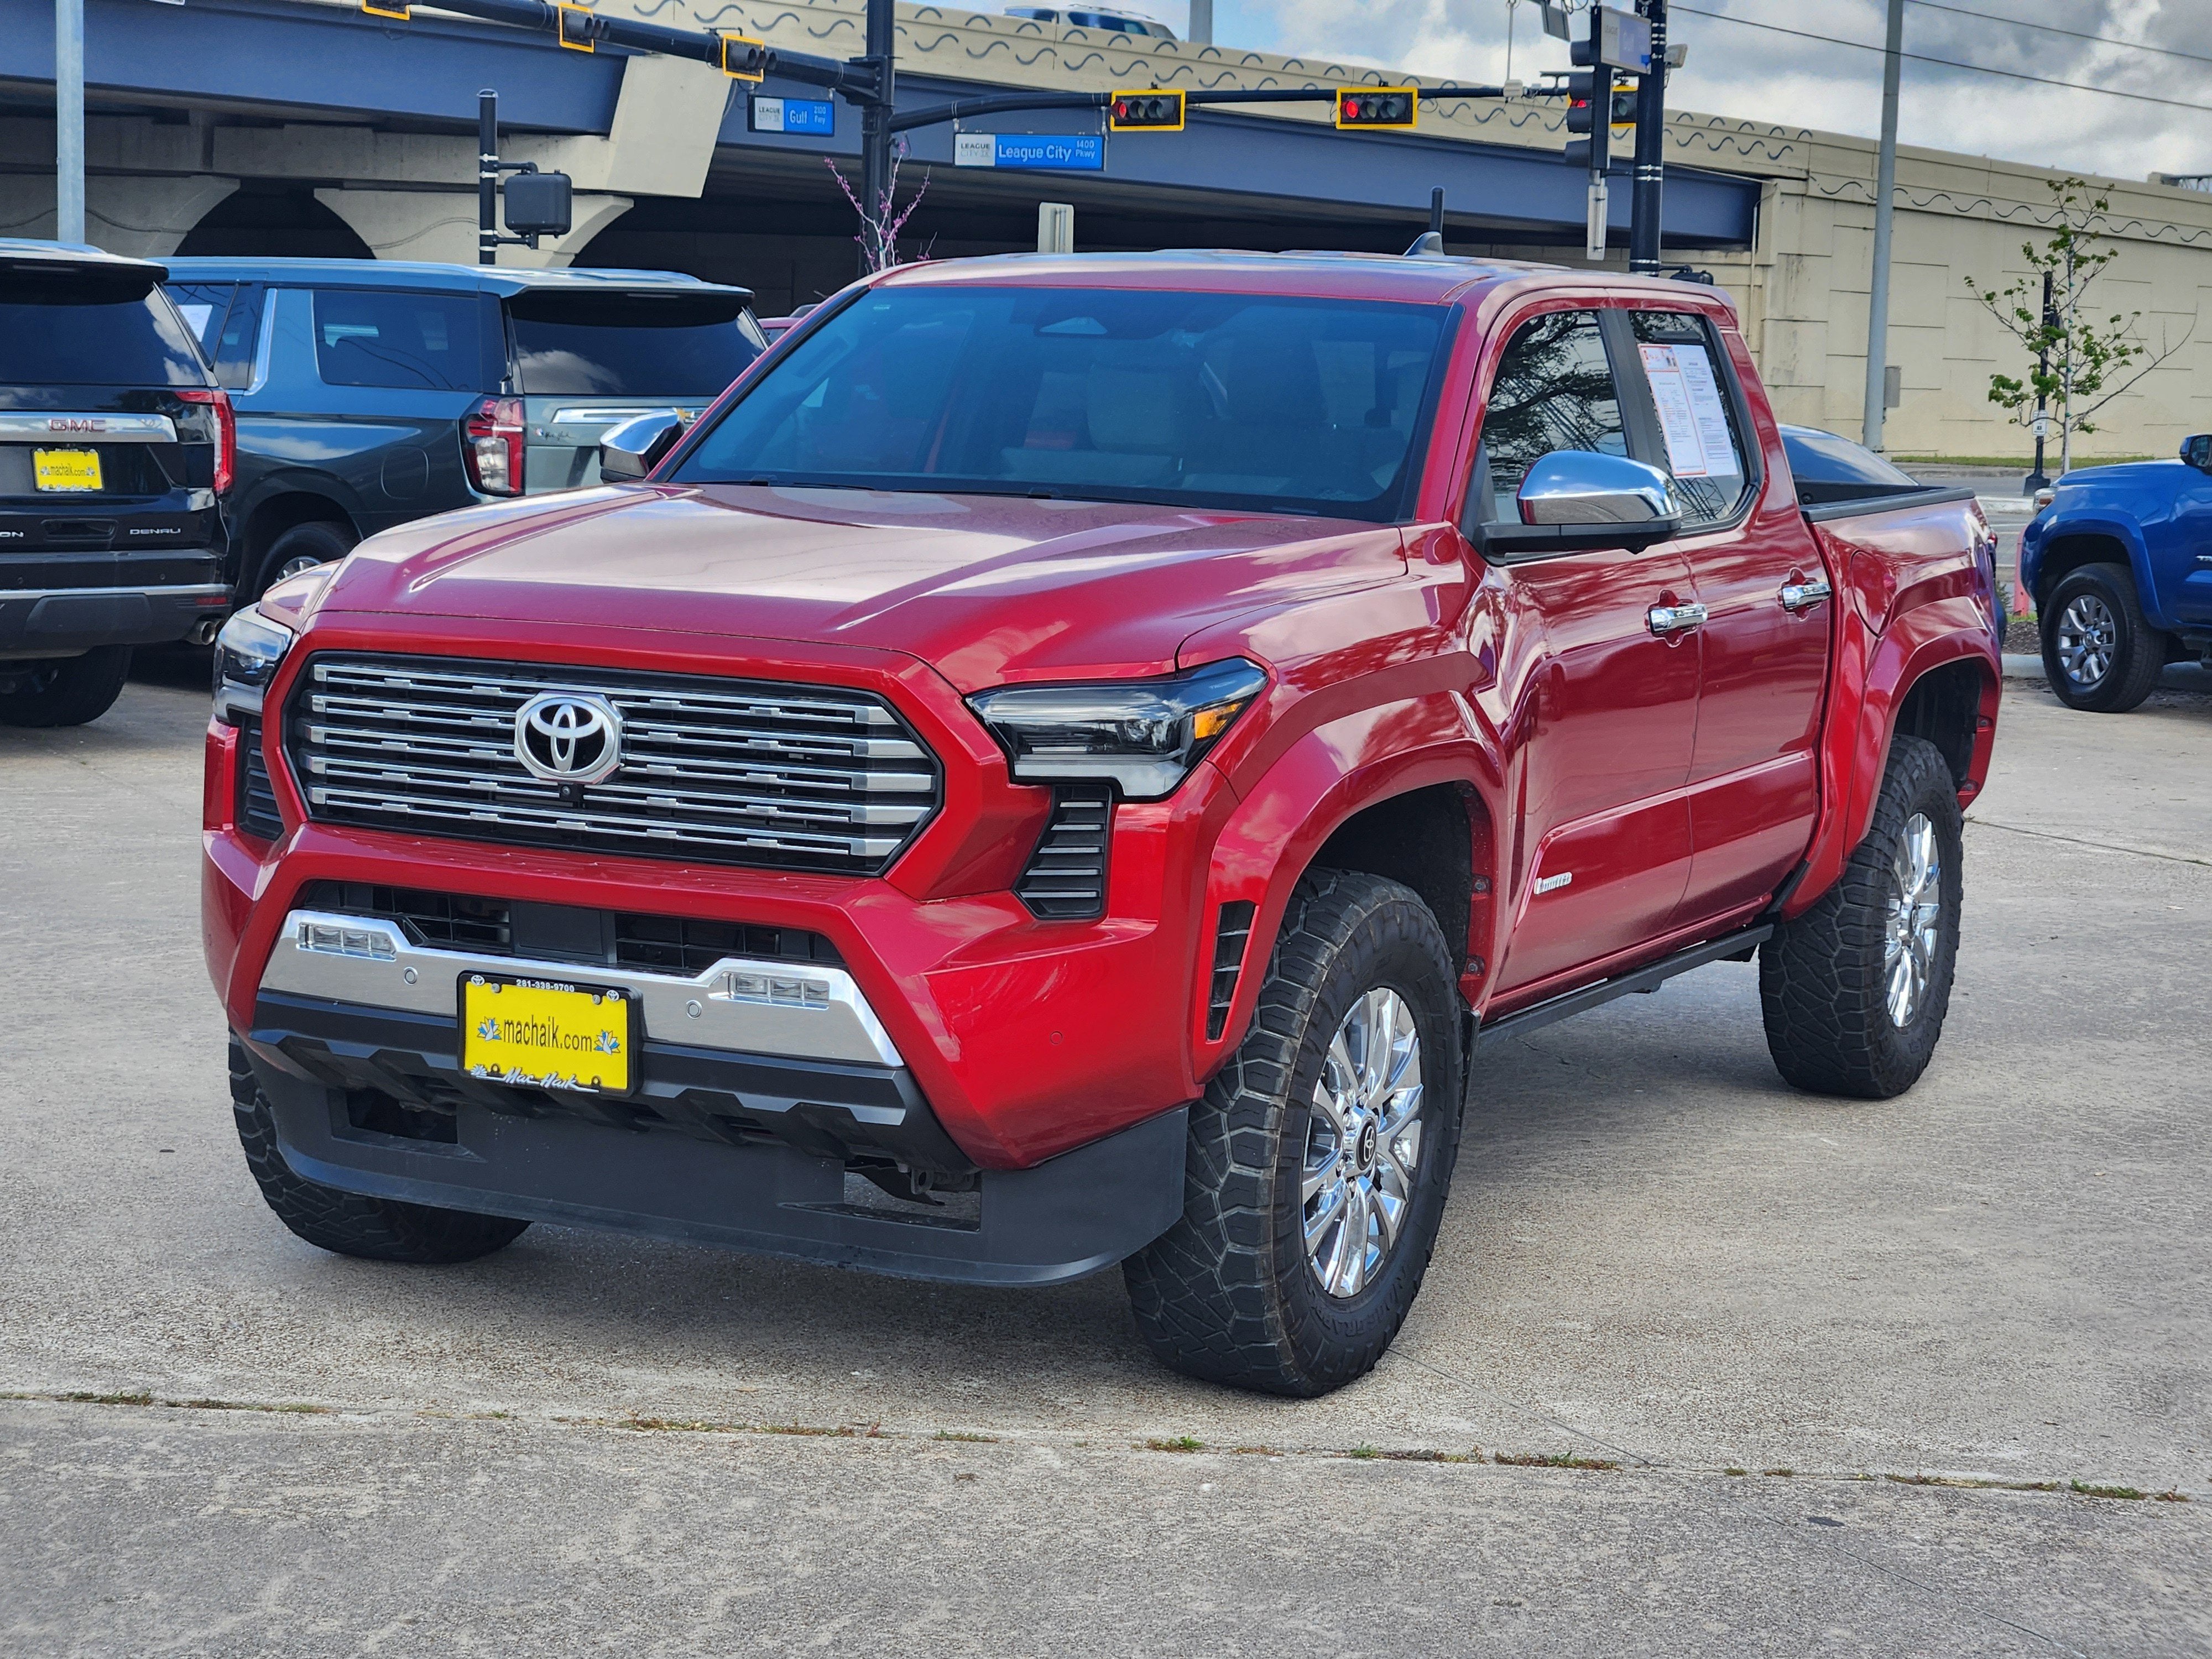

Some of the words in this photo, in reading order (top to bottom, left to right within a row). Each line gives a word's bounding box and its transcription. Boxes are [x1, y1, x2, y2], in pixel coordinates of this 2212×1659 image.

[790, 110, 807, 124] Gulf
[1077, 139, 1094, 148] 1400
[999, 144, 1044, 162] League
[1046, 144, 1072, 162] City
[1075, 149, 1095, 159] Pkwy
[48, 419, 106, 432] GMC
[503, 1014, 592, 1052] machaik.com
[502, 1067, 540, 1084] Mac
[539, 1071, 593, 1092] Haik
